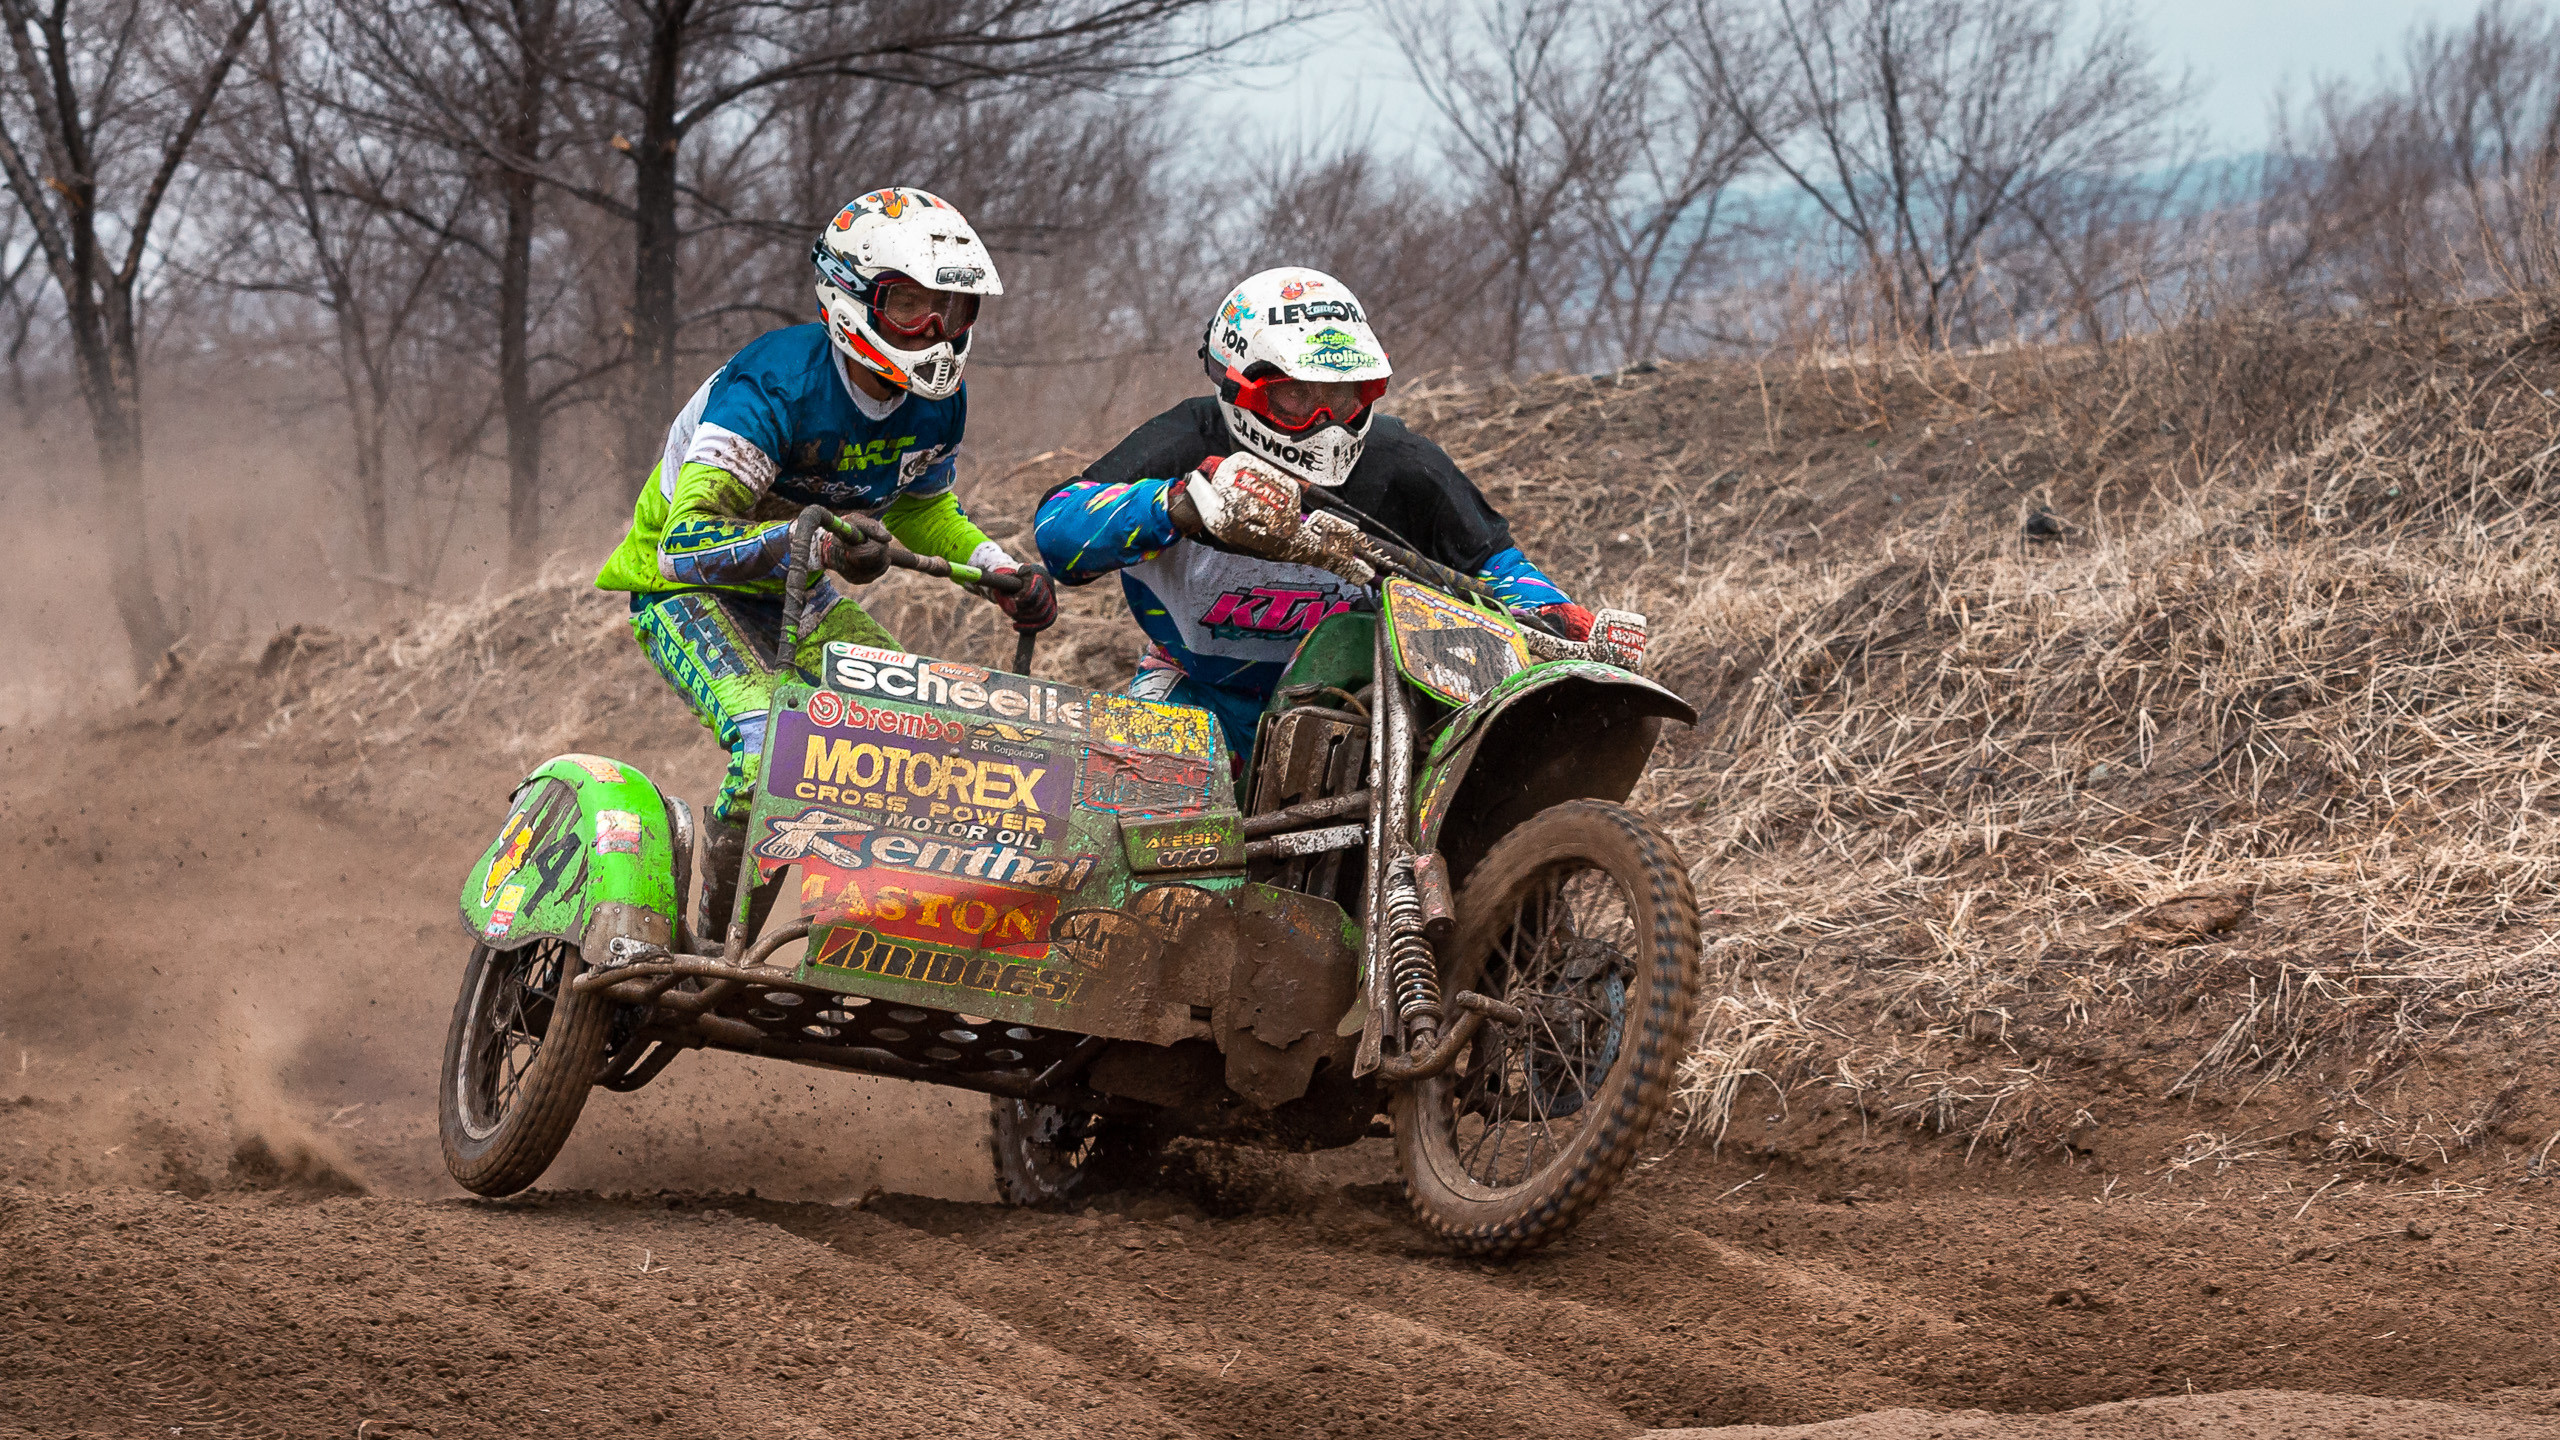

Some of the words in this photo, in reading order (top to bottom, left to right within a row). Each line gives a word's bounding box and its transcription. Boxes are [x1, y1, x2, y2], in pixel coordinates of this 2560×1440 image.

[849, 646, 906, 665] Castrol
[846, 699, 965, 745] brembo
[970, 739, 989, 752] SK
[803, 735, 1046, 811] MOTOREX
[794, 781, 908, 813] CROSS
[928, 803, 1047, 834] POWER
[885, 812, 989, 841] MOTOR
[996, 831, 1038, 849] OIL
[1157, 847, 1219, 868] UFO
[817, 929, 1083, 1003] BRIDGES
